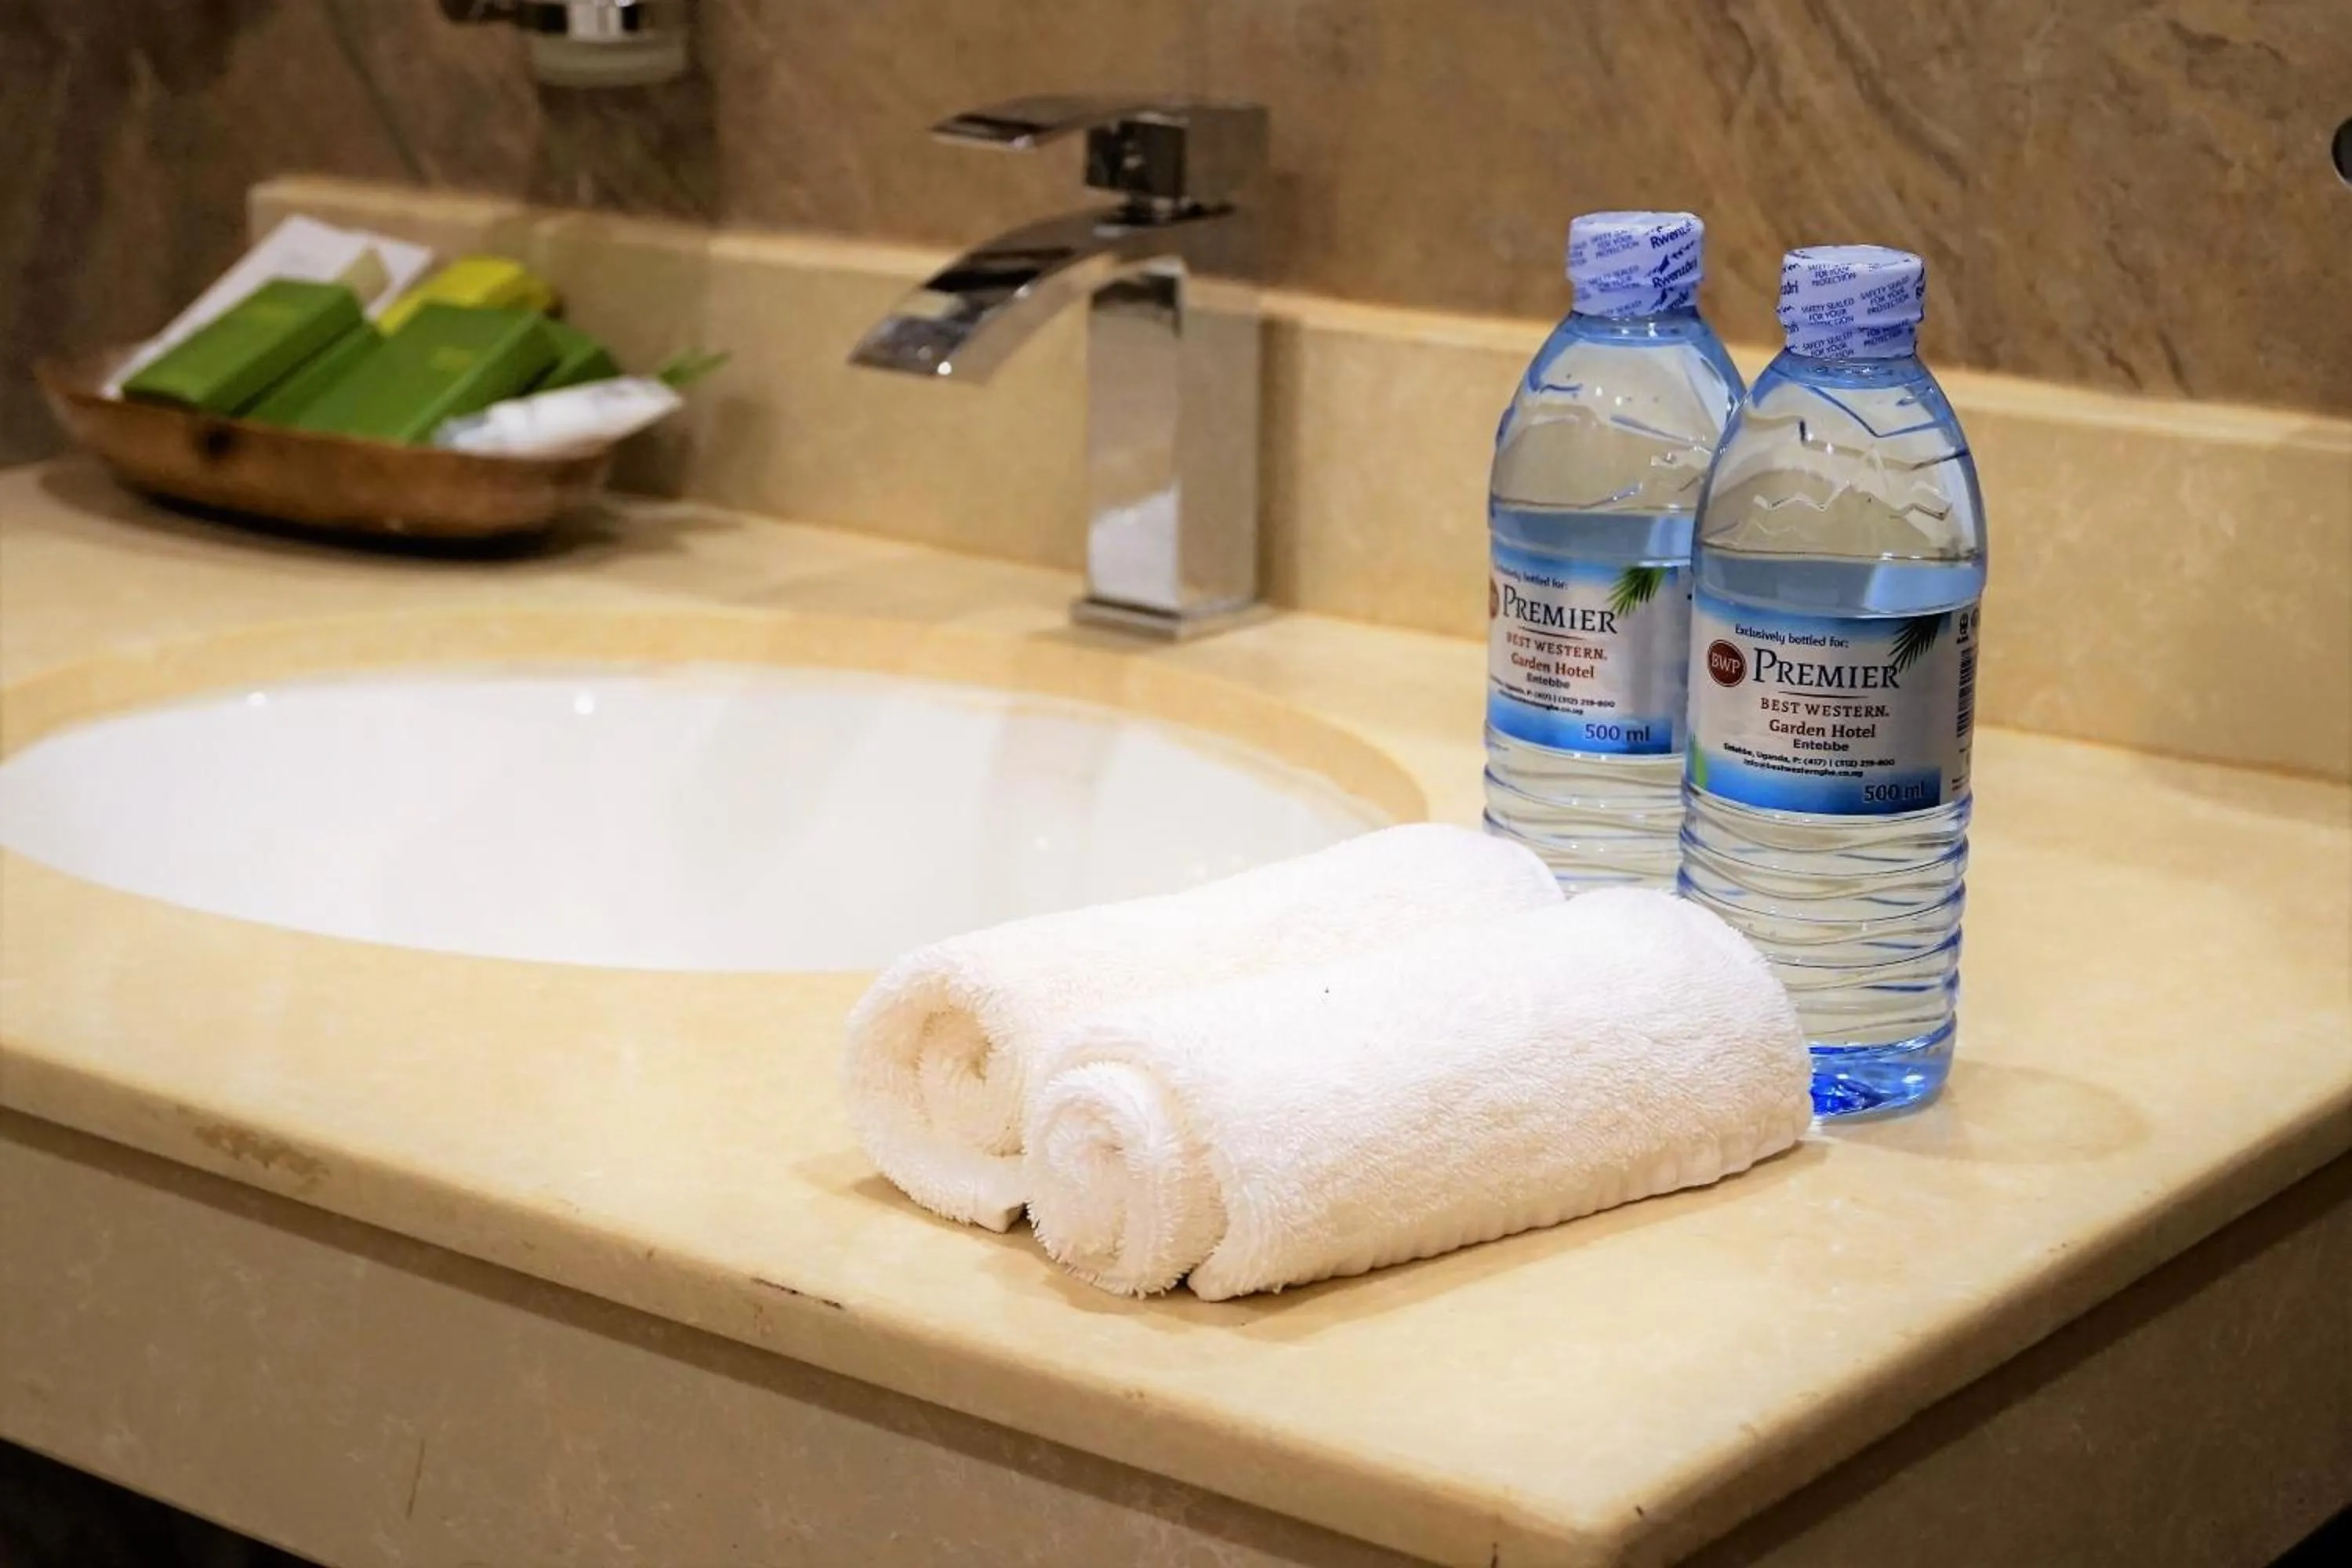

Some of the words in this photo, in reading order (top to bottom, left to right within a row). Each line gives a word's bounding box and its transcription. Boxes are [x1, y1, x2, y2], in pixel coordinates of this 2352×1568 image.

[1503, 583, 1618, 634] PREMIER
[1505, 630, 1531, 649] BEST
[1734, 622, 1786, 644] Exclusively
[1788, 632, 1827, 647] bottled
[1510, 652, 1551, 673] Garden
[1555, 661, 1595, 679] Hotel
[1711, 652, 1742, 674] BWP
[1751, 646, 1901, 690] PREMIER
[1526, 672, 1571, 689] Entebbe
[1760, 697, 1802, 715] BEST
[1584, 723, 1621, 741] 500
[1625, 724, 1650, 742] ml
[1768, 718, 1827, 738] Garden
[1831, 724, 1877, 739] Hotel
[1792, 739, 1849, 753] Entebbe
[1862, 782, 1900, 803] 500
[1902, 781, 1925, 800] ml
